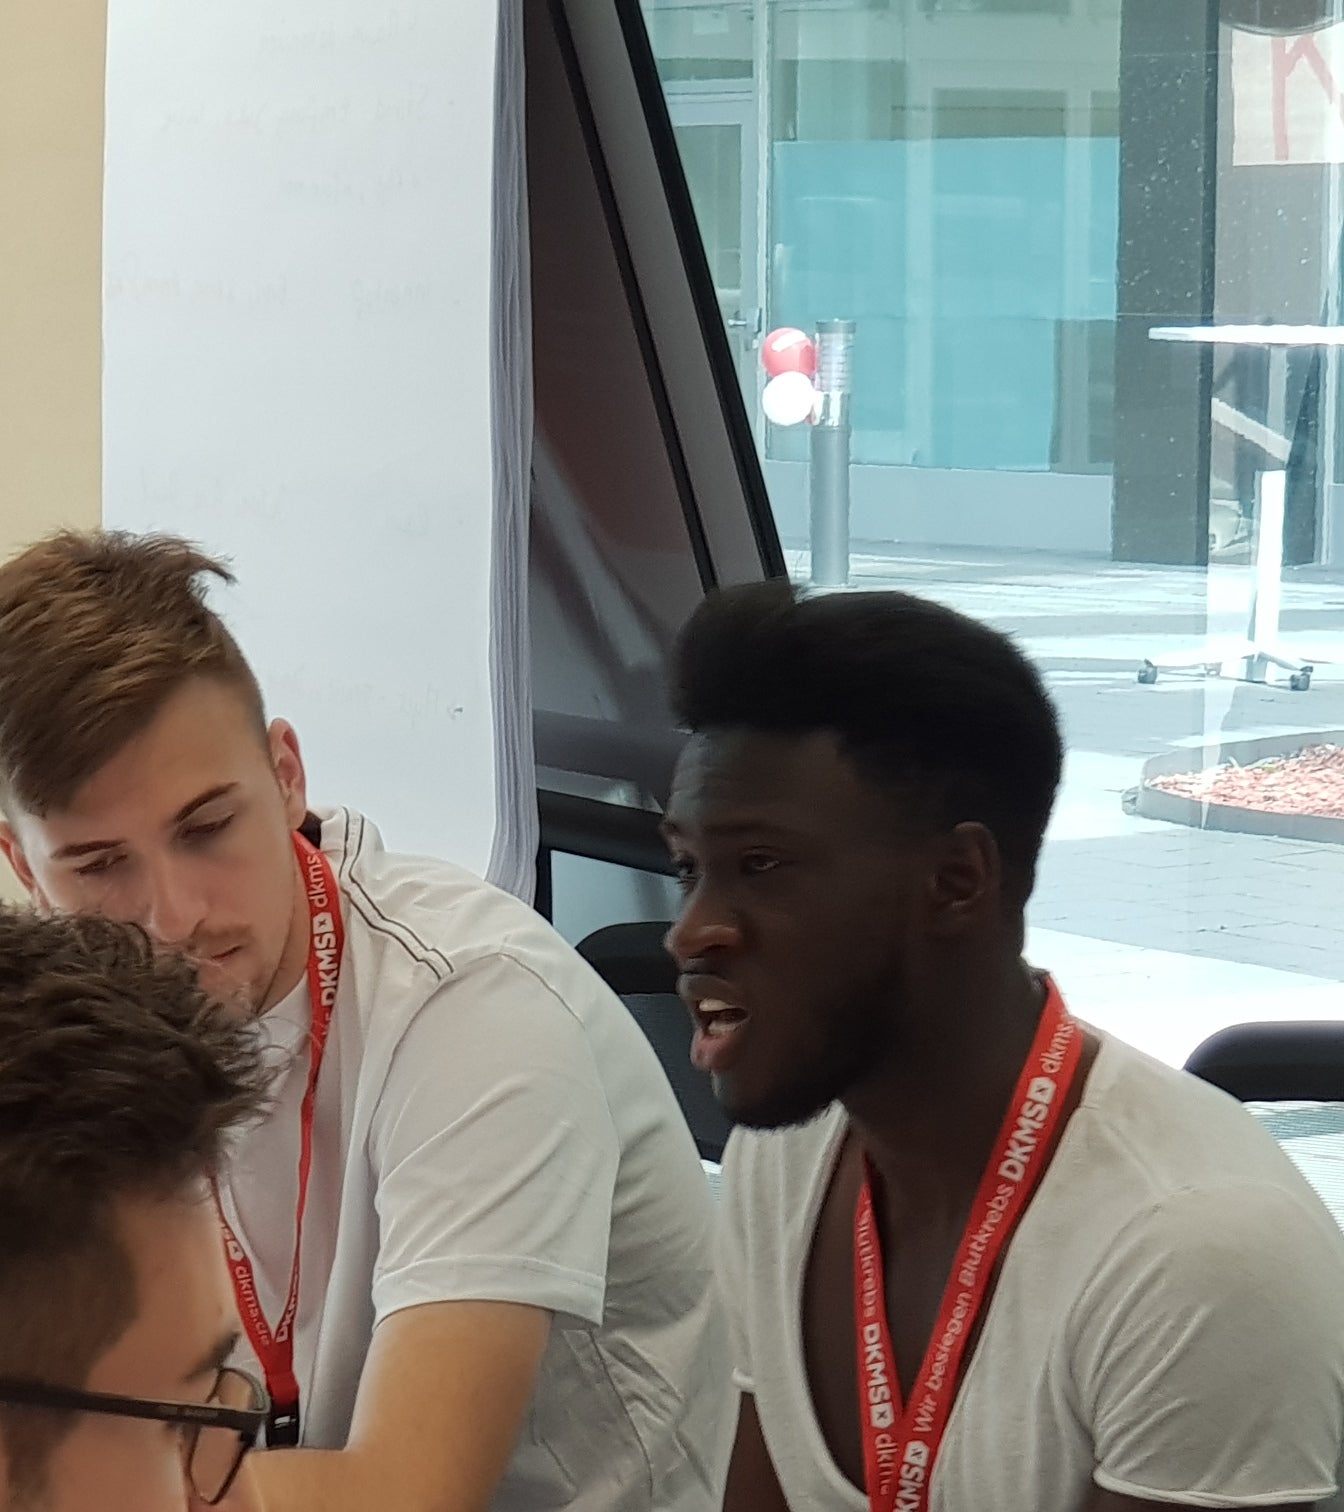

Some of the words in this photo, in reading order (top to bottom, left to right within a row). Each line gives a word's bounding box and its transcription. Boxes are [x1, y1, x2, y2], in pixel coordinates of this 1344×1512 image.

[313, 932, 340, 1008] DKMS
[997, 1100, 1049, 1182] DKMS
[958, 1182, 1017, 1288] Blutkrebs
[862, 1322, 893, 1406] DKMS
[924, 1291, 973, 1391] besiegen
[912, 1394, 938, 1433] Wir
